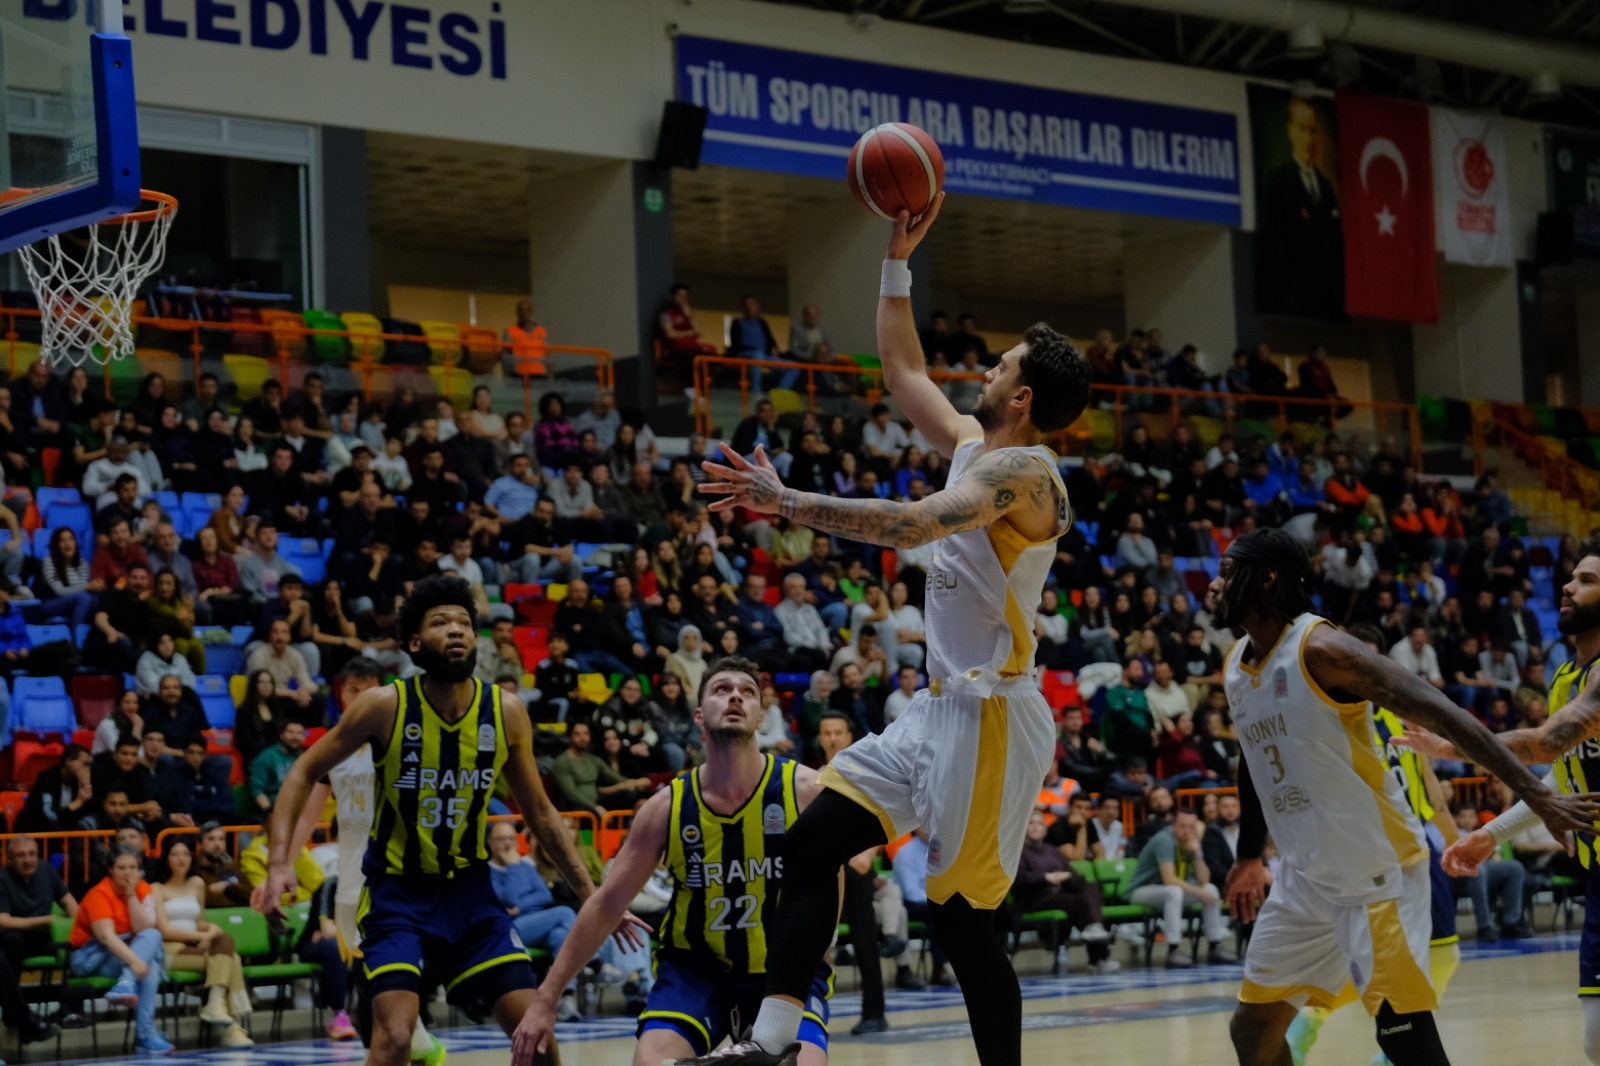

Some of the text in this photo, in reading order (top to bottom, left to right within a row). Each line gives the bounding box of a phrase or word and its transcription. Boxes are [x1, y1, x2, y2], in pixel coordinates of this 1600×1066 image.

[686, 60, 759, 120] TÜM
[972, 104, 1124, 166] BAŞARILAR
[1241, 712, 1288, 750] KONYA
[419, 768, 495, 790] RAMS
[1263, 743, 1285, 785] 3
[421, 796, 467, 829] 35
[704, 856, 784, 887] RAMS
[709, 894, 758, 931] 22
[1380, 1021, 1413, 1036] hummel
